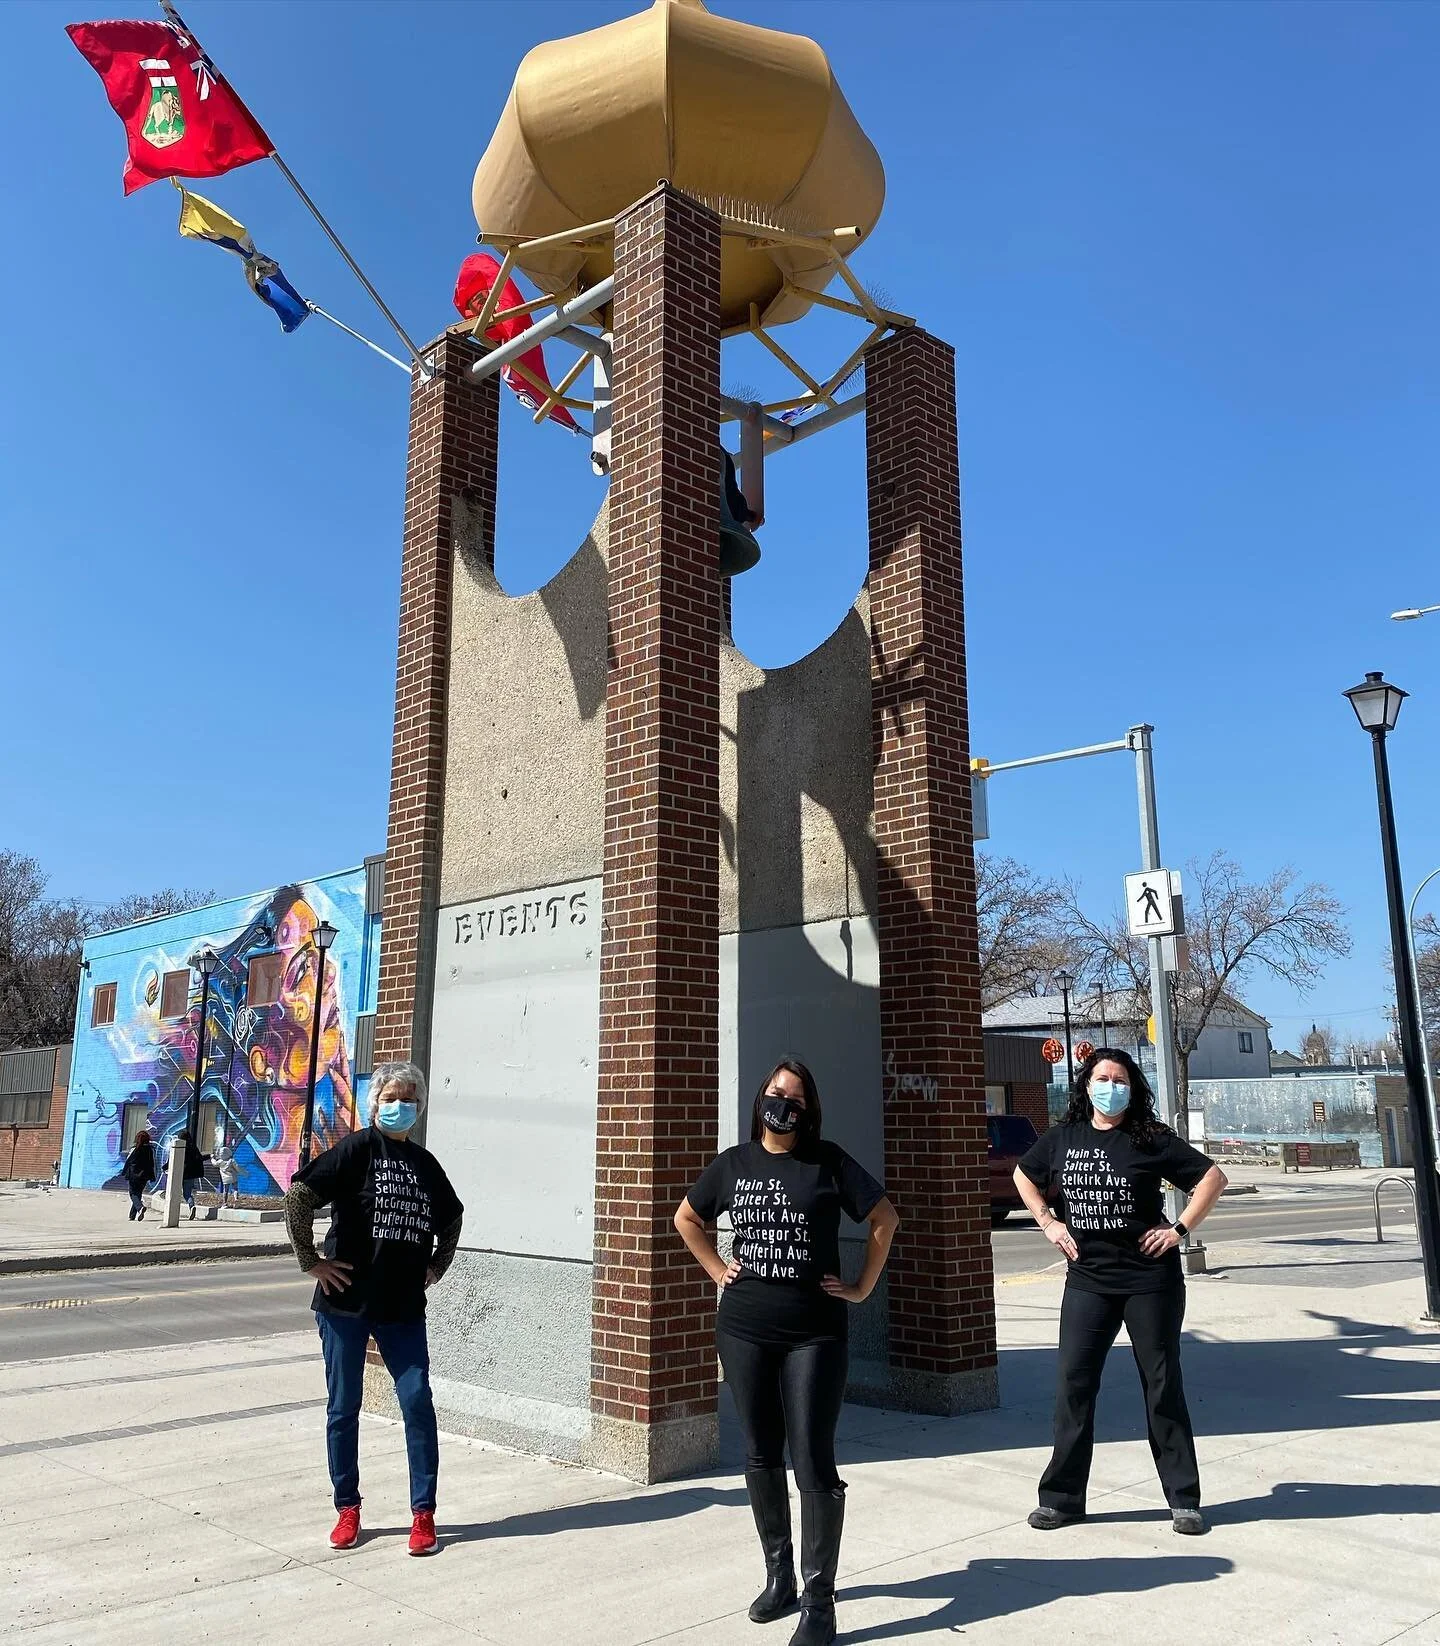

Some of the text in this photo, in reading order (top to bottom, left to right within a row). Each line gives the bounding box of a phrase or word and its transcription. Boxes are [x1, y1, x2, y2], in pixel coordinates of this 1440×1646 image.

[454, 891, 588, 944] EVENTS
[1066, 1148, 1108, 1159] Main St.
[374, 1158, 412, 1172] Main St.
[1064, 1161, 1115, 1172] Salter St.
[375, 1170, 404, 1183] Salter
[1062, 1174, 1131, 1187] Selkirk Ave.
[376, 1183, 411, 1197] Selkirk
[735, 1178, 784, 1191] Main St.
[733, 1193, 791, 1208] Salter St.
[1063, 1188, 1135, 1203] McGregor St.
[375, 1197, 432, 1217] McGregor St.
[1069, 1202, 1135, 1217] Dufferin Ave.
[374, 1211, 431, 1232] Dufferin Ave.
[732, 1209, 809, 1225] Selkirk Ave.
[1071, 1216, 1127, 1229] Euclid Ave.
[373, 1226, 421, 1244] Euclid Ave.
[795, 1228, 811, 1243] St.
[787, 1246, 812, 1261] Ave.
[772, 1263, 799, 1279] Ave.
